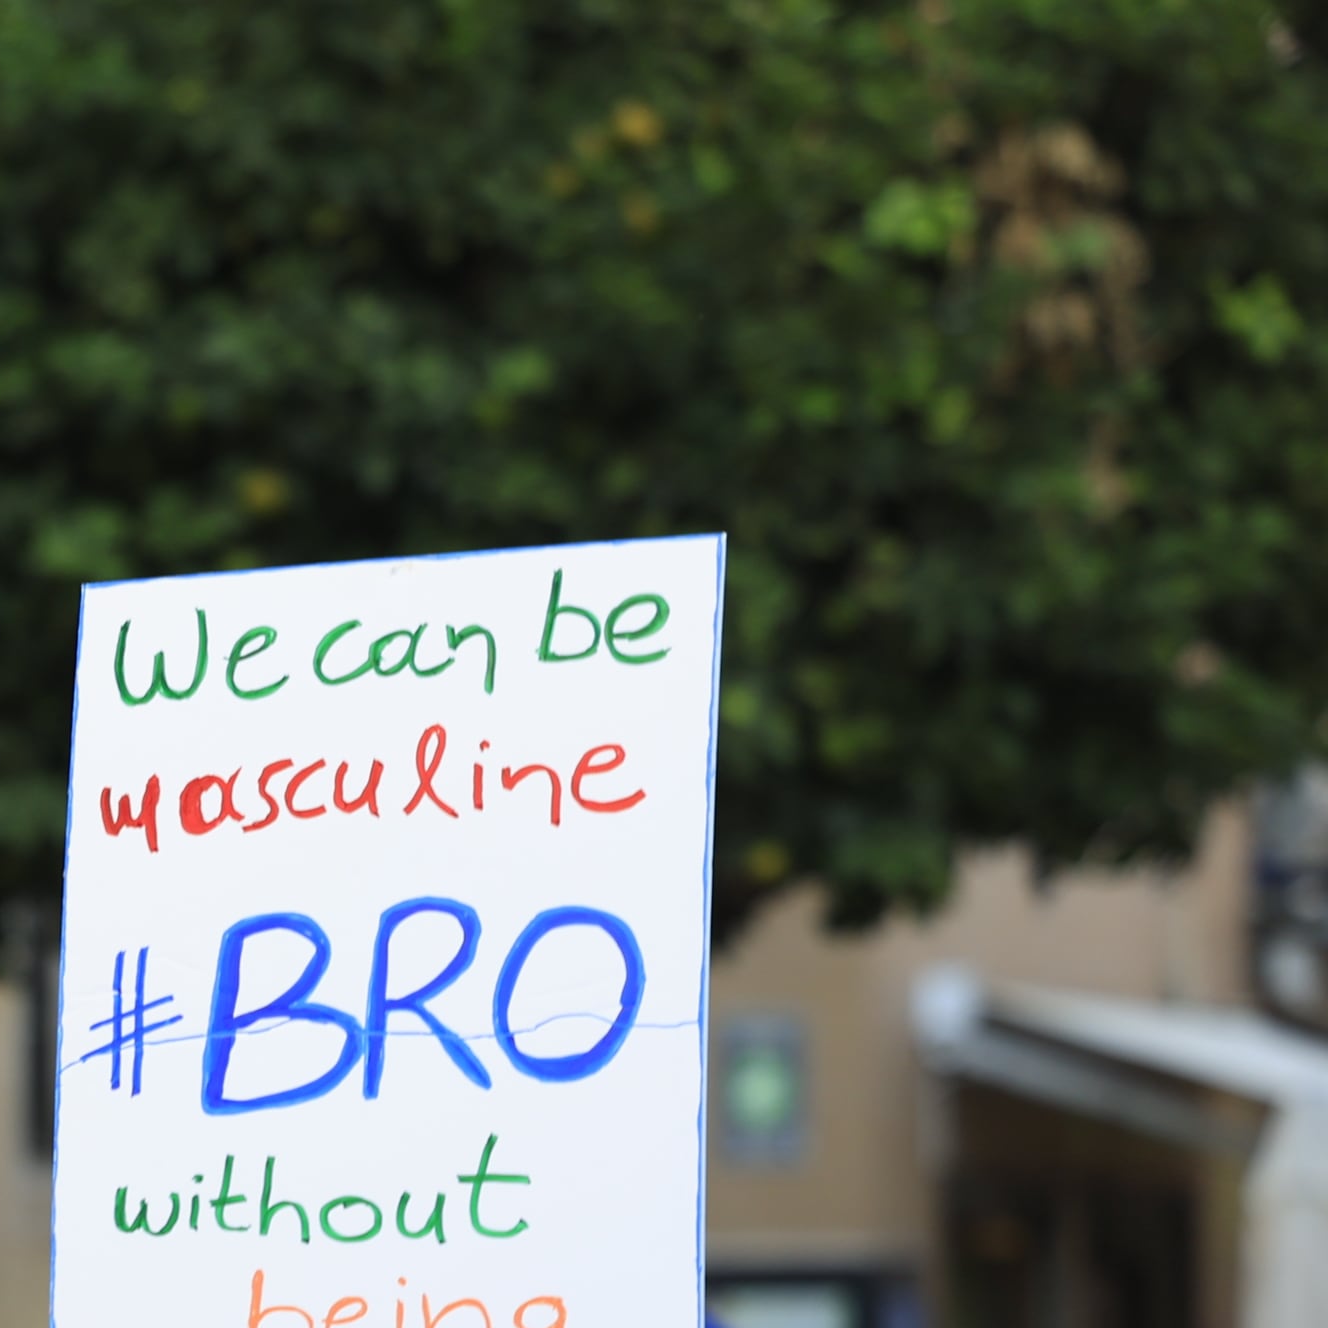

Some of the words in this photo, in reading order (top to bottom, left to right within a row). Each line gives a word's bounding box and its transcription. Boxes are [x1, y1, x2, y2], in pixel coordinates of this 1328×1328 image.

[113, 607, 290, 706] We
[313, 619, 497, 694] can
[538, 568, 672, 666] be
[100, 722, 646, 853] masculine
[80, 896, 646, 1115] #BRO
[112, 1133, 531, 1244] without
